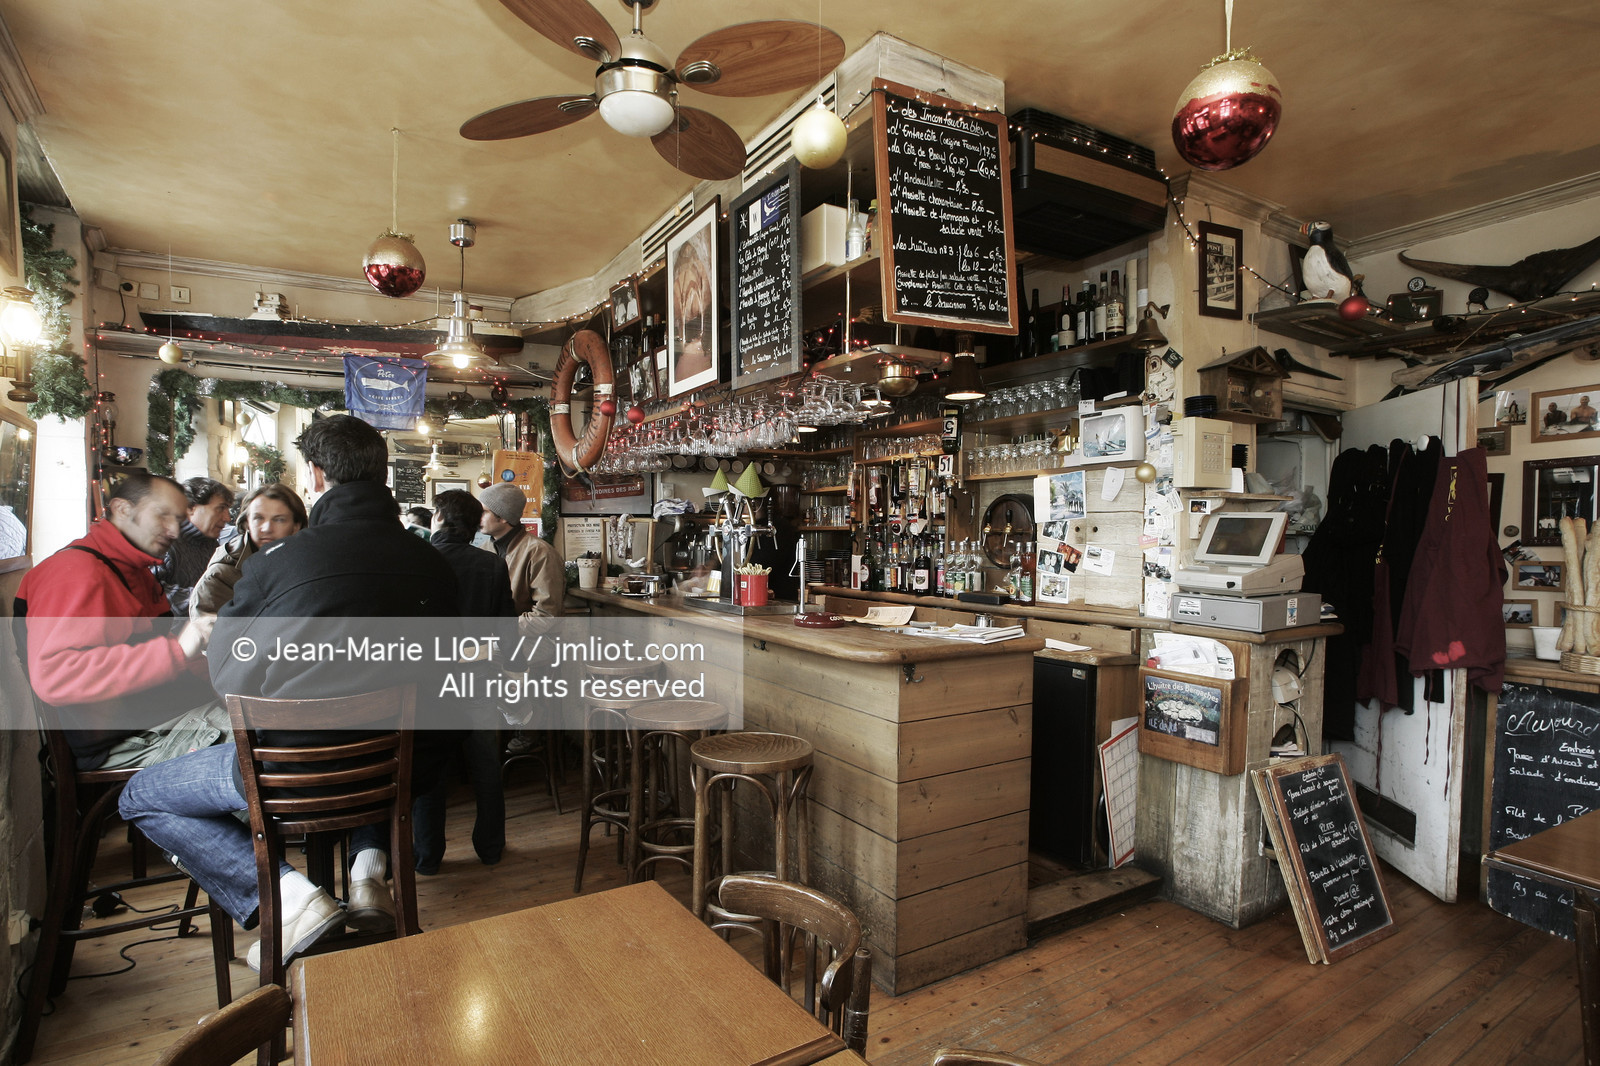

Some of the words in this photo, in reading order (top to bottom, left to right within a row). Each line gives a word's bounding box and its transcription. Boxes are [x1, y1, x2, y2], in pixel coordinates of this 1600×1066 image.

[377, 369, 395, 378] Peter
[940, 457, 950, 472] 51
[1172, 682, 1184, 691] des
[1587, 760, 1599, 769] et
[1509, 767, 1545, 778] Salade
[1505, 806, 1526, 818] Filet
[1533, 813, 1547, 823] de
[1535, 890, 1548, 899] au
